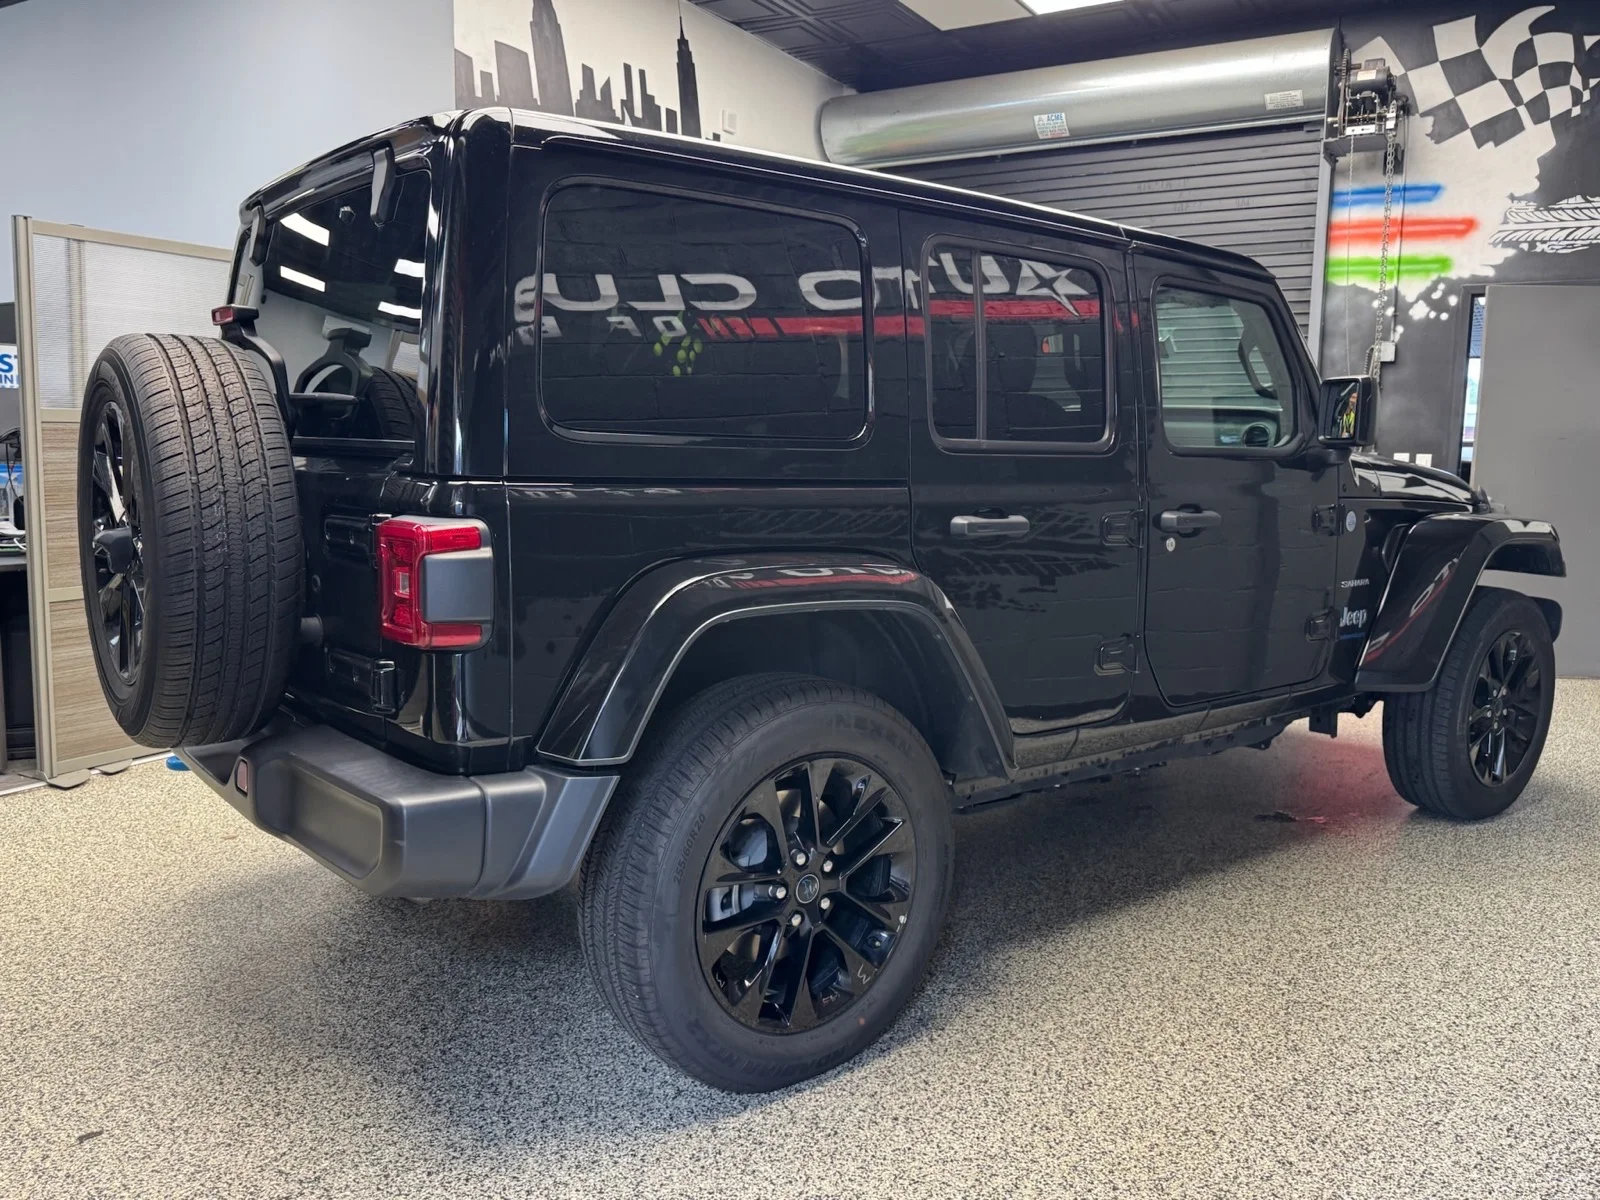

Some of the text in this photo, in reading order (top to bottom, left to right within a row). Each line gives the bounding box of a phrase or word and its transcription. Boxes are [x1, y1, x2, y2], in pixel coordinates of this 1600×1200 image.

[1340, 578, 1370, 588] SAHARA
[1339, 606, 1367, 628] Jeep
[673, 813, 706, 886] 255/60R20
